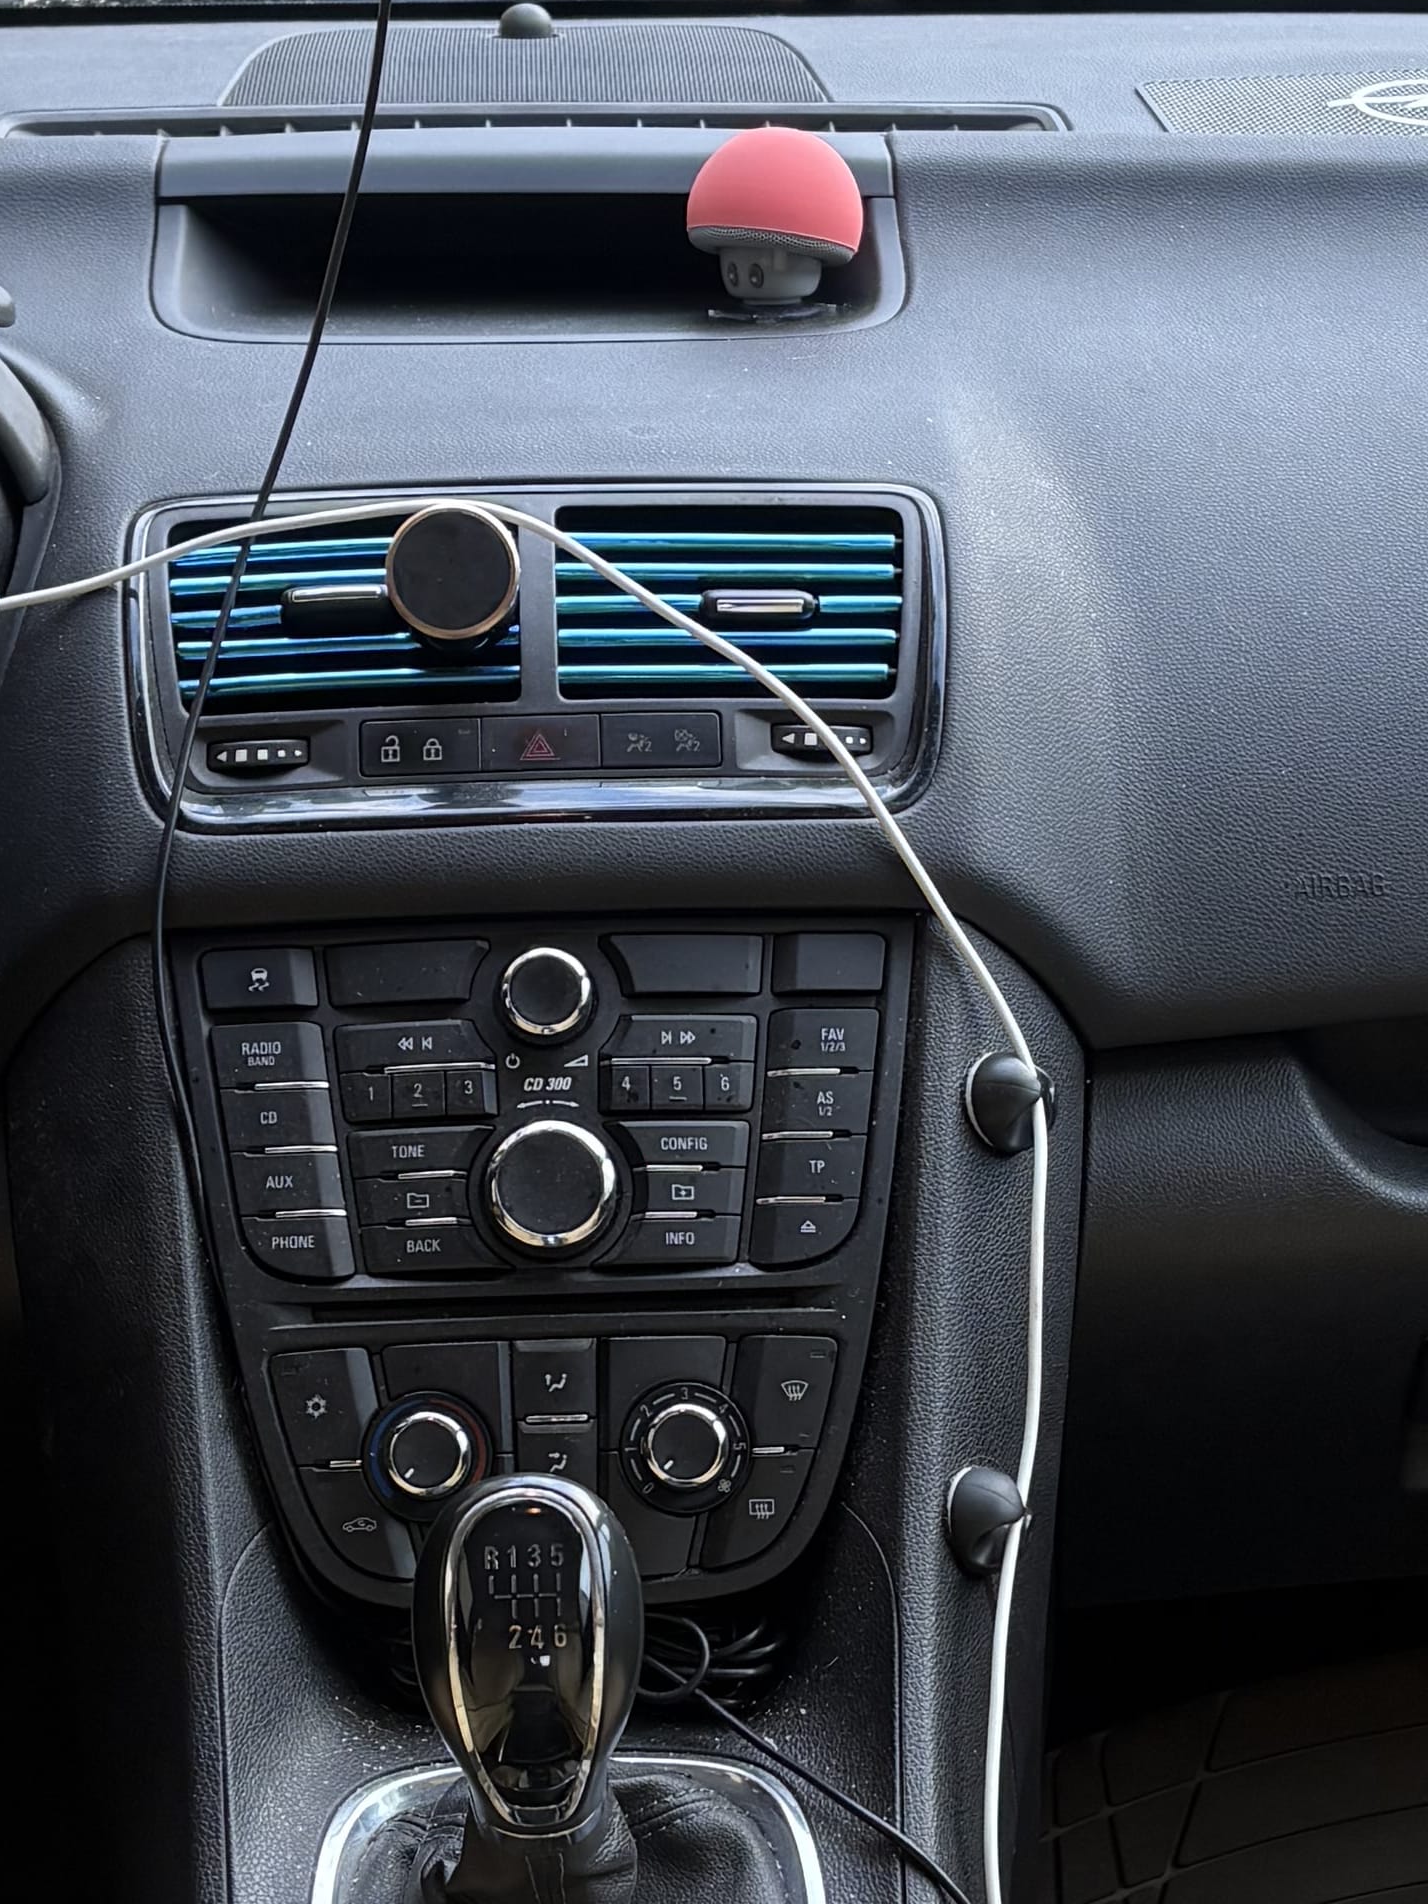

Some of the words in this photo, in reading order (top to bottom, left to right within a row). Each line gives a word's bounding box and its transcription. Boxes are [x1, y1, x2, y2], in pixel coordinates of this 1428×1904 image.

[1294, 872, 1388, 898] AIRBAG
[819, 1027, 846, 1043] FAV
[241, 1041, 282, 1056] RADIO
[820, 1041, 847, 1053] 1/2/3
[247, 1055, 276, 1068] BAND
[413, 1082, 423, 1098] 2
[464, 1079, 474, 1095] 3
[523, 1076, 544, 1092] CD
[544, 1076, 573, 1092] 300
[621, 1076, 631, 1092] 4
[673, 1076, 683, 1092] 5
[720, 1075, 730, 1092] 6
[368, 1086, 375, 1102] 1
[816, 1089, 835, 1105] AS
[260, 1110, 279, 1126] CD
[818, 1105, 833, 1117] 1/2
[660, 1136, 709, 1151] CONFIG
[391, 1144, 426, 1160] TONE
[809, 1160, 826, 1174] TP
[265, 1174, 294, 1190] AUX
[271, 1234, 316, 1250] PHONE
[406, 1238, 442, 1254] BACK
[665, 1231, 696, 1246] INFO
[681, 1387, 690, 1400] 3
[640, 1404, 653, 1418] 2
[734, 1442, 747, 1451] 5
[643, 1482, 654, 1494] 0
[484, 1545, 500, 1571] R
[507, 1544, 518, 1569] 1
[527, 1543, 542, 1568] 3
[550, 1543, 565, 1567] 5
[508, 1624, 522, 1650] 2
[528, 1625, 545, 1651] 4
[554, 1624, 568, 1649] 6
